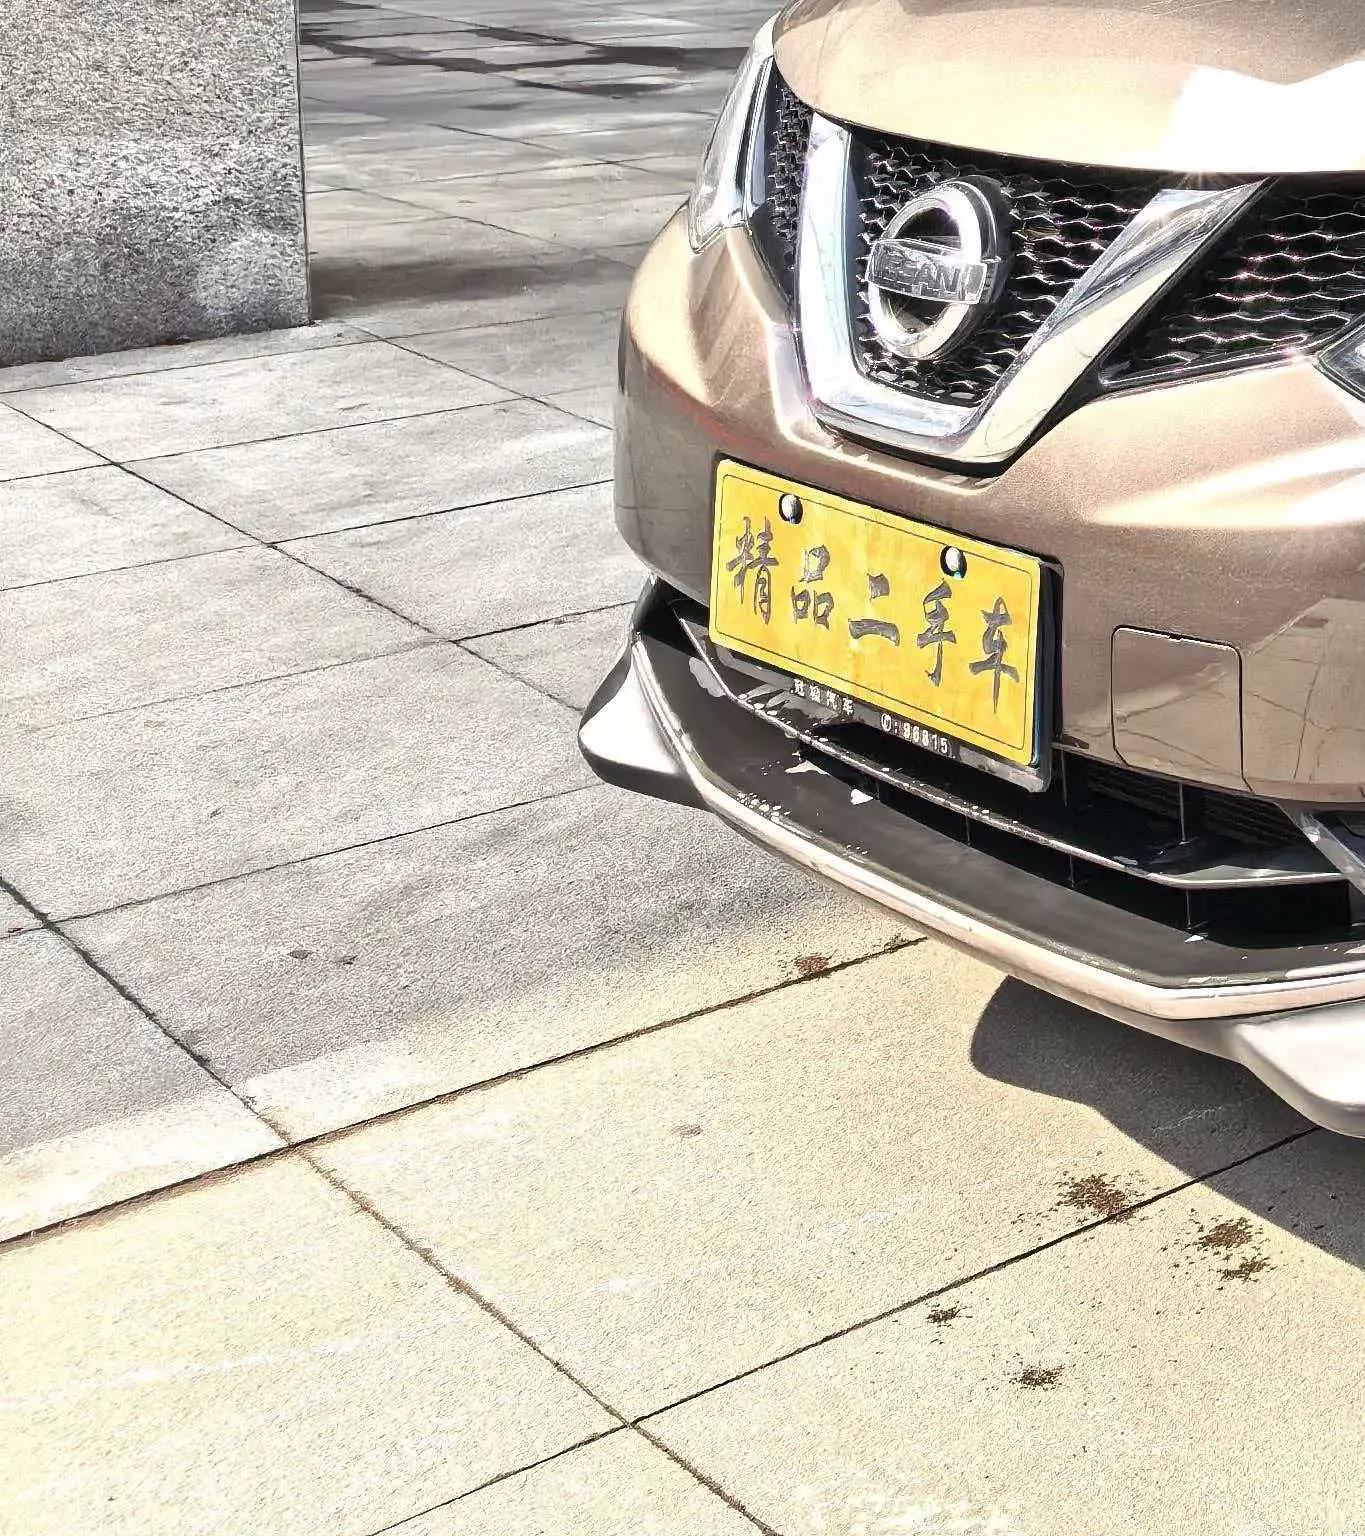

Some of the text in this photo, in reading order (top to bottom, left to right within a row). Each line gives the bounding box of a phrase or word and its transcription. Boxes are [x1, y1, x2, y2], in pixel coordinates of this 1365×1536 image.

[725, 515, 1019, 714] 精品二手车
